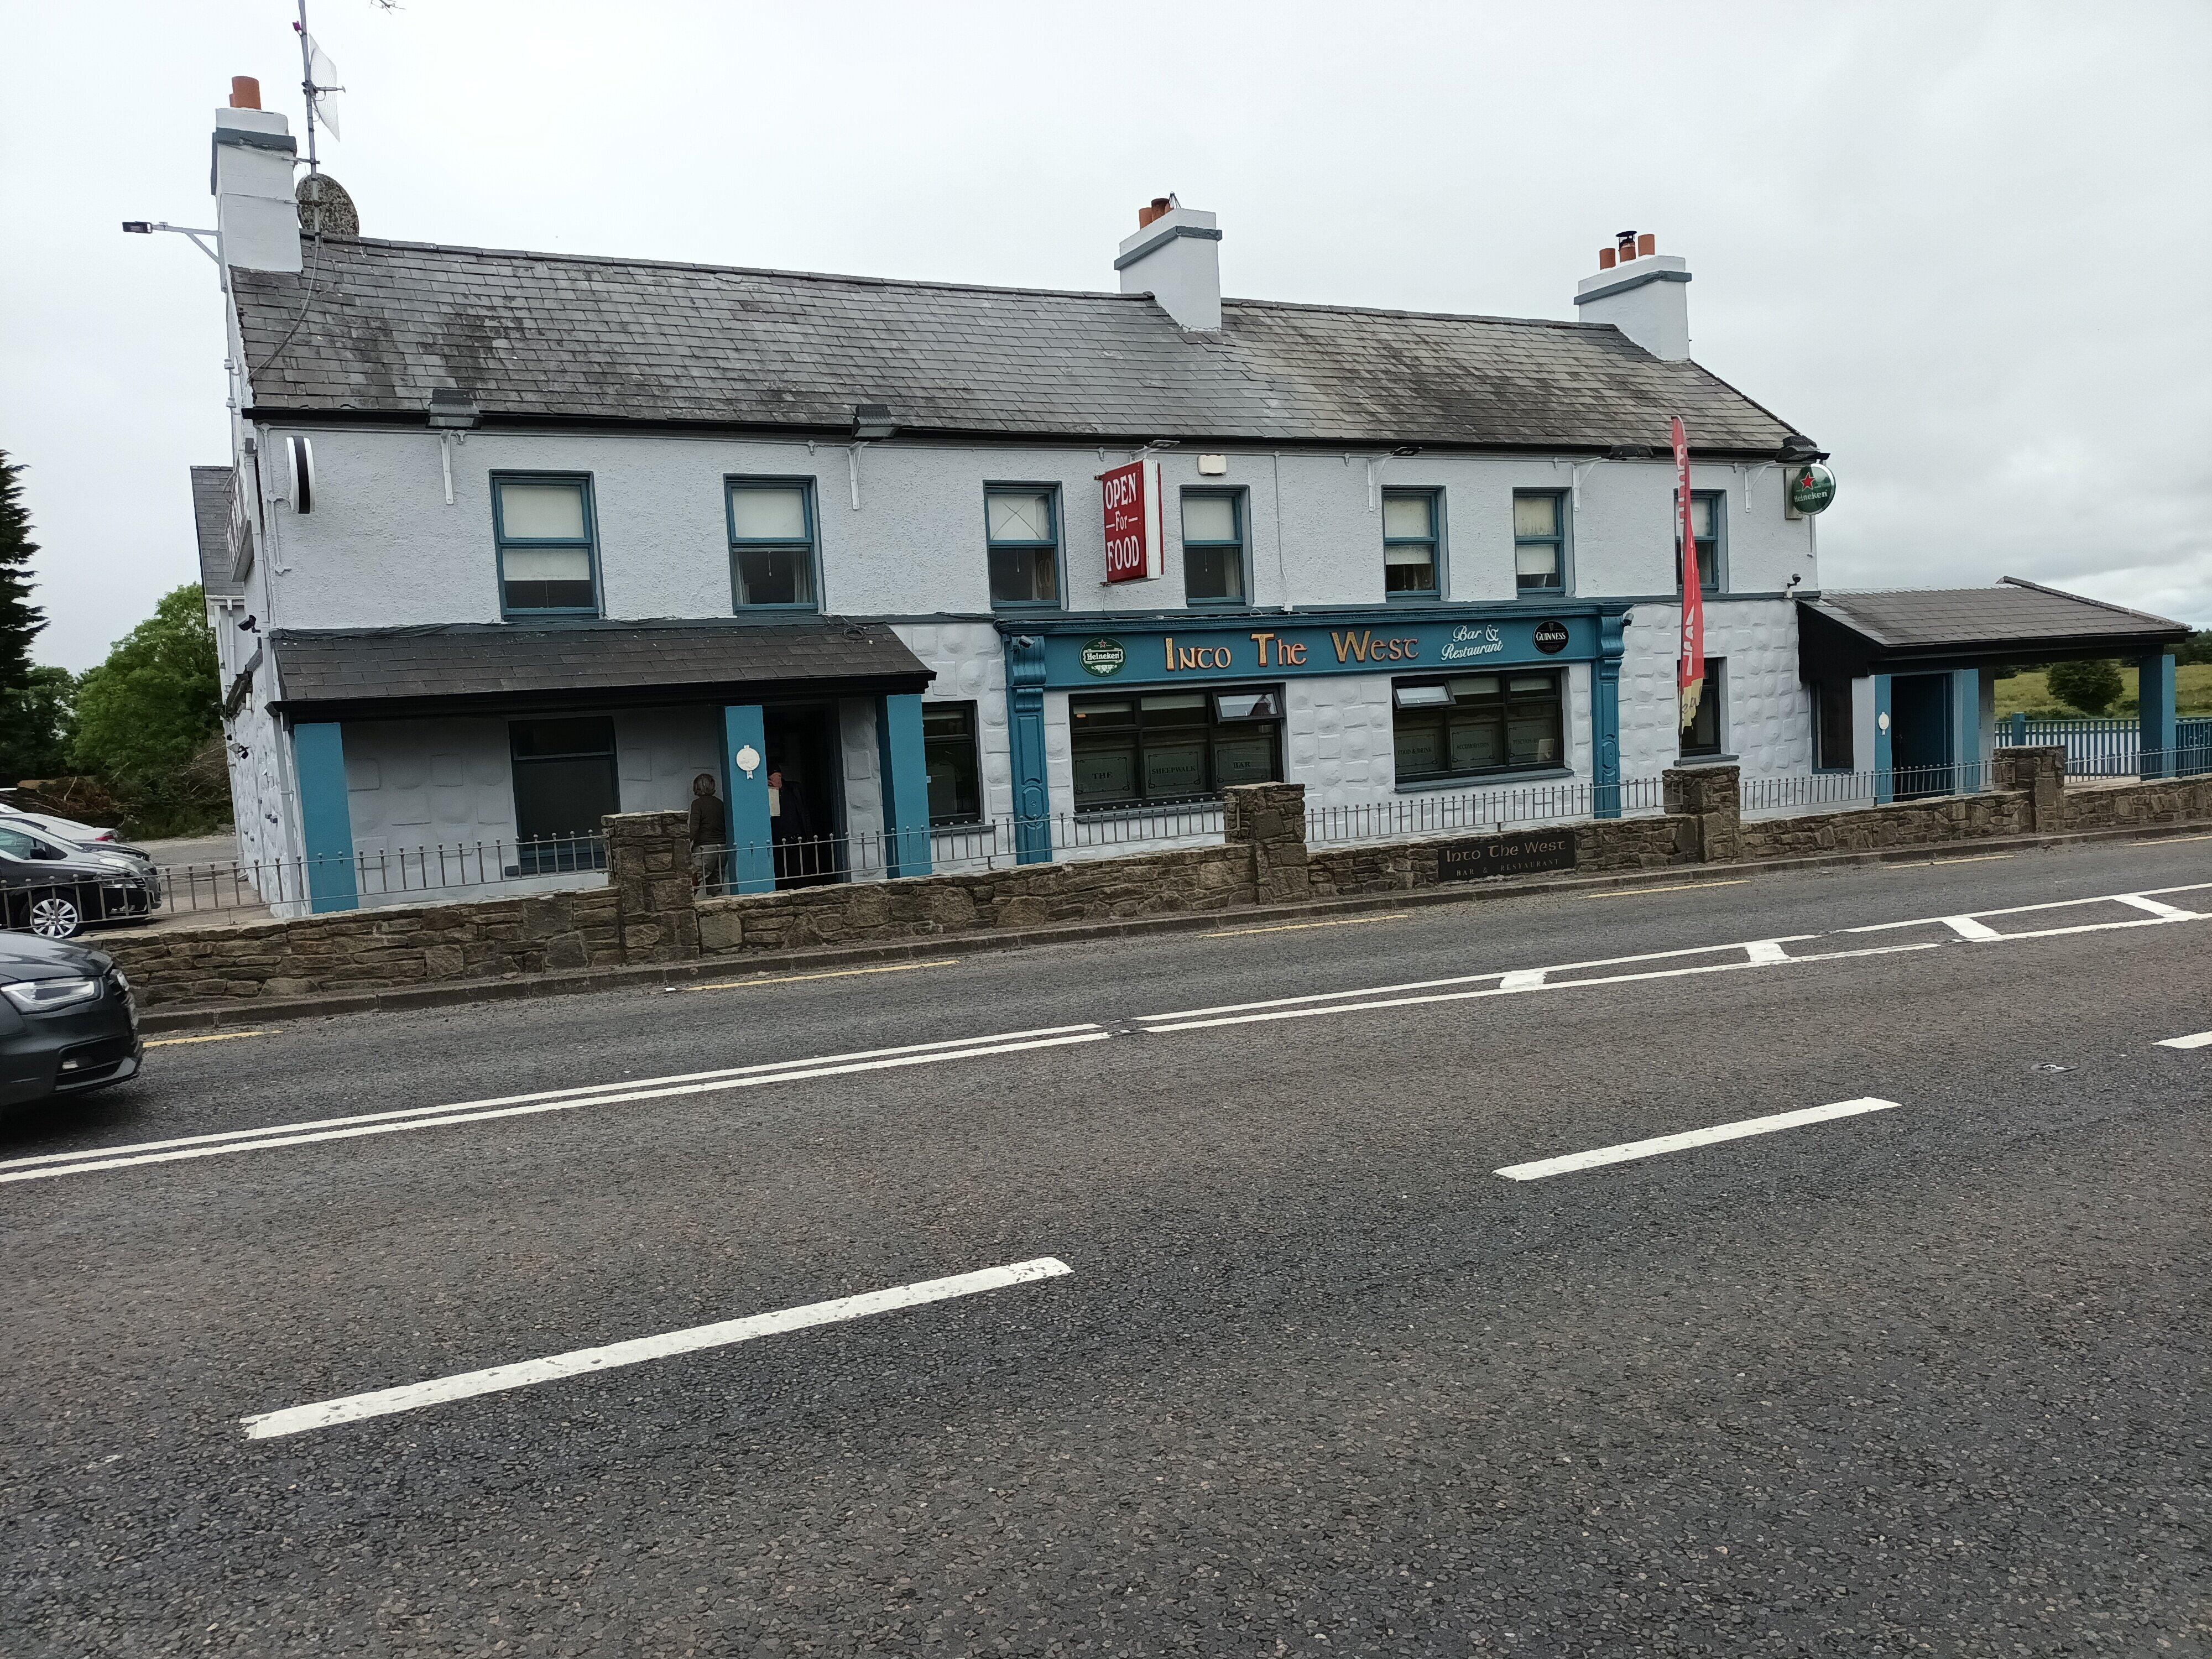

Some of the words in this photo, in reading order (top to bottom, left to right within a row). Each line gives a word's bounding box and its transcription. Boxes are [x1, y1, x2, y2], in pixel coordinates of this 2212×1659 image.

[1105, 472, 1137, 510] OPEN
[1794, 491, 1828, 503] Heineken
[1107, 535, 1140, 572] FOOD
[1453, 625, 1483, 642] Bar
[1485, 624, 1499, 642] &
[1536, 632, 1566, 641] GUINNESS
[1087, 652, 1120, 660] Heineken
[1249, 633, 1308, 667] The
[1329, 630, 1420, 663] West
[1441, 640, 1504, 661] Restaurant
[1152, 766, 1196, 775] SHEEPWALK
[1447, 849, 1481, 862] Into
[1488, 844, 1519, 858] The
[1524, 841, 1566, 854] West
[1457, 868, 1474, 877] BAR
[1500, 858, 1559, 872] RESTAURANT
